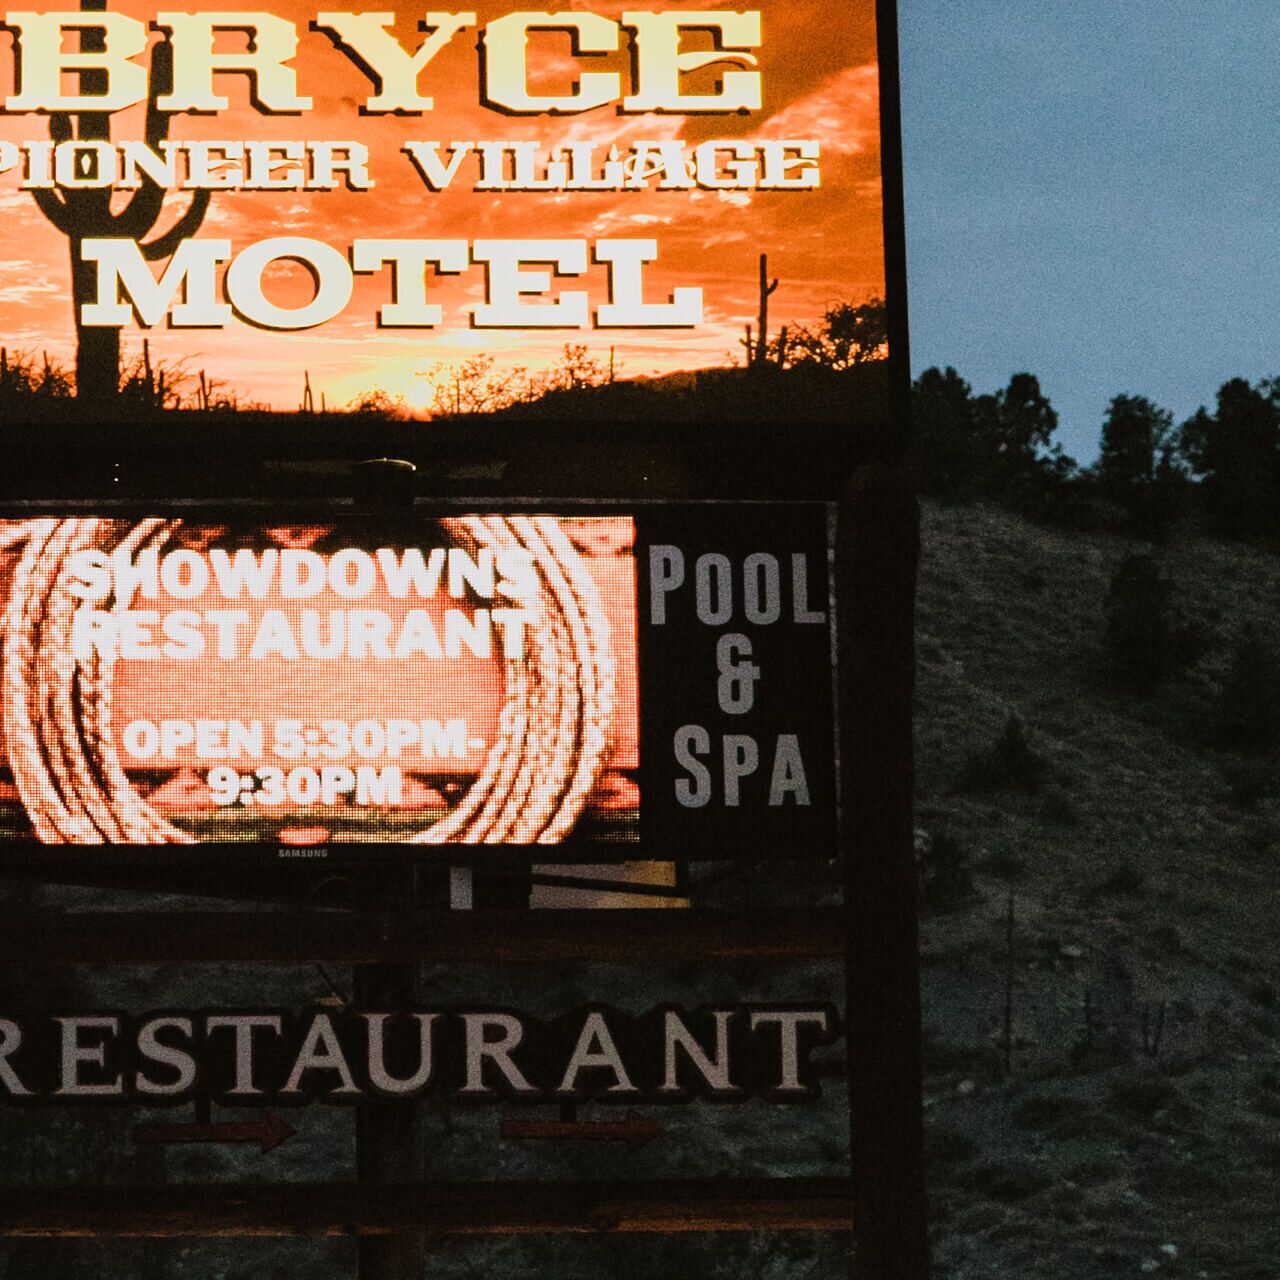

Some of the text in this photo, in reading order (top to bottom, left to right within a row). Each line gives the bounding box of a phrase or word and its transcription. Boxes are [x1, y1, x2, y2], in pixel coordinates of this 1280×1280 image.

[0, 10, 763, 113] BRYCE
[405, 139, 821, 191] VILLAGE
[80, 238, 704, 328] MOTEL
[70, 548, 540, 599] SHOWDOWNS
[649, 544, 826, 626] POOL
[72, 609, 536, 660] RESTAURANT
[716, 632, 761, 715] &
[122, 719, 262, 758] OPEN
[206, 766, 402, 806] 9:30PM
[673, 724, 811, 809] SPA
[278, 849, 328, 858] SAMSUNG
